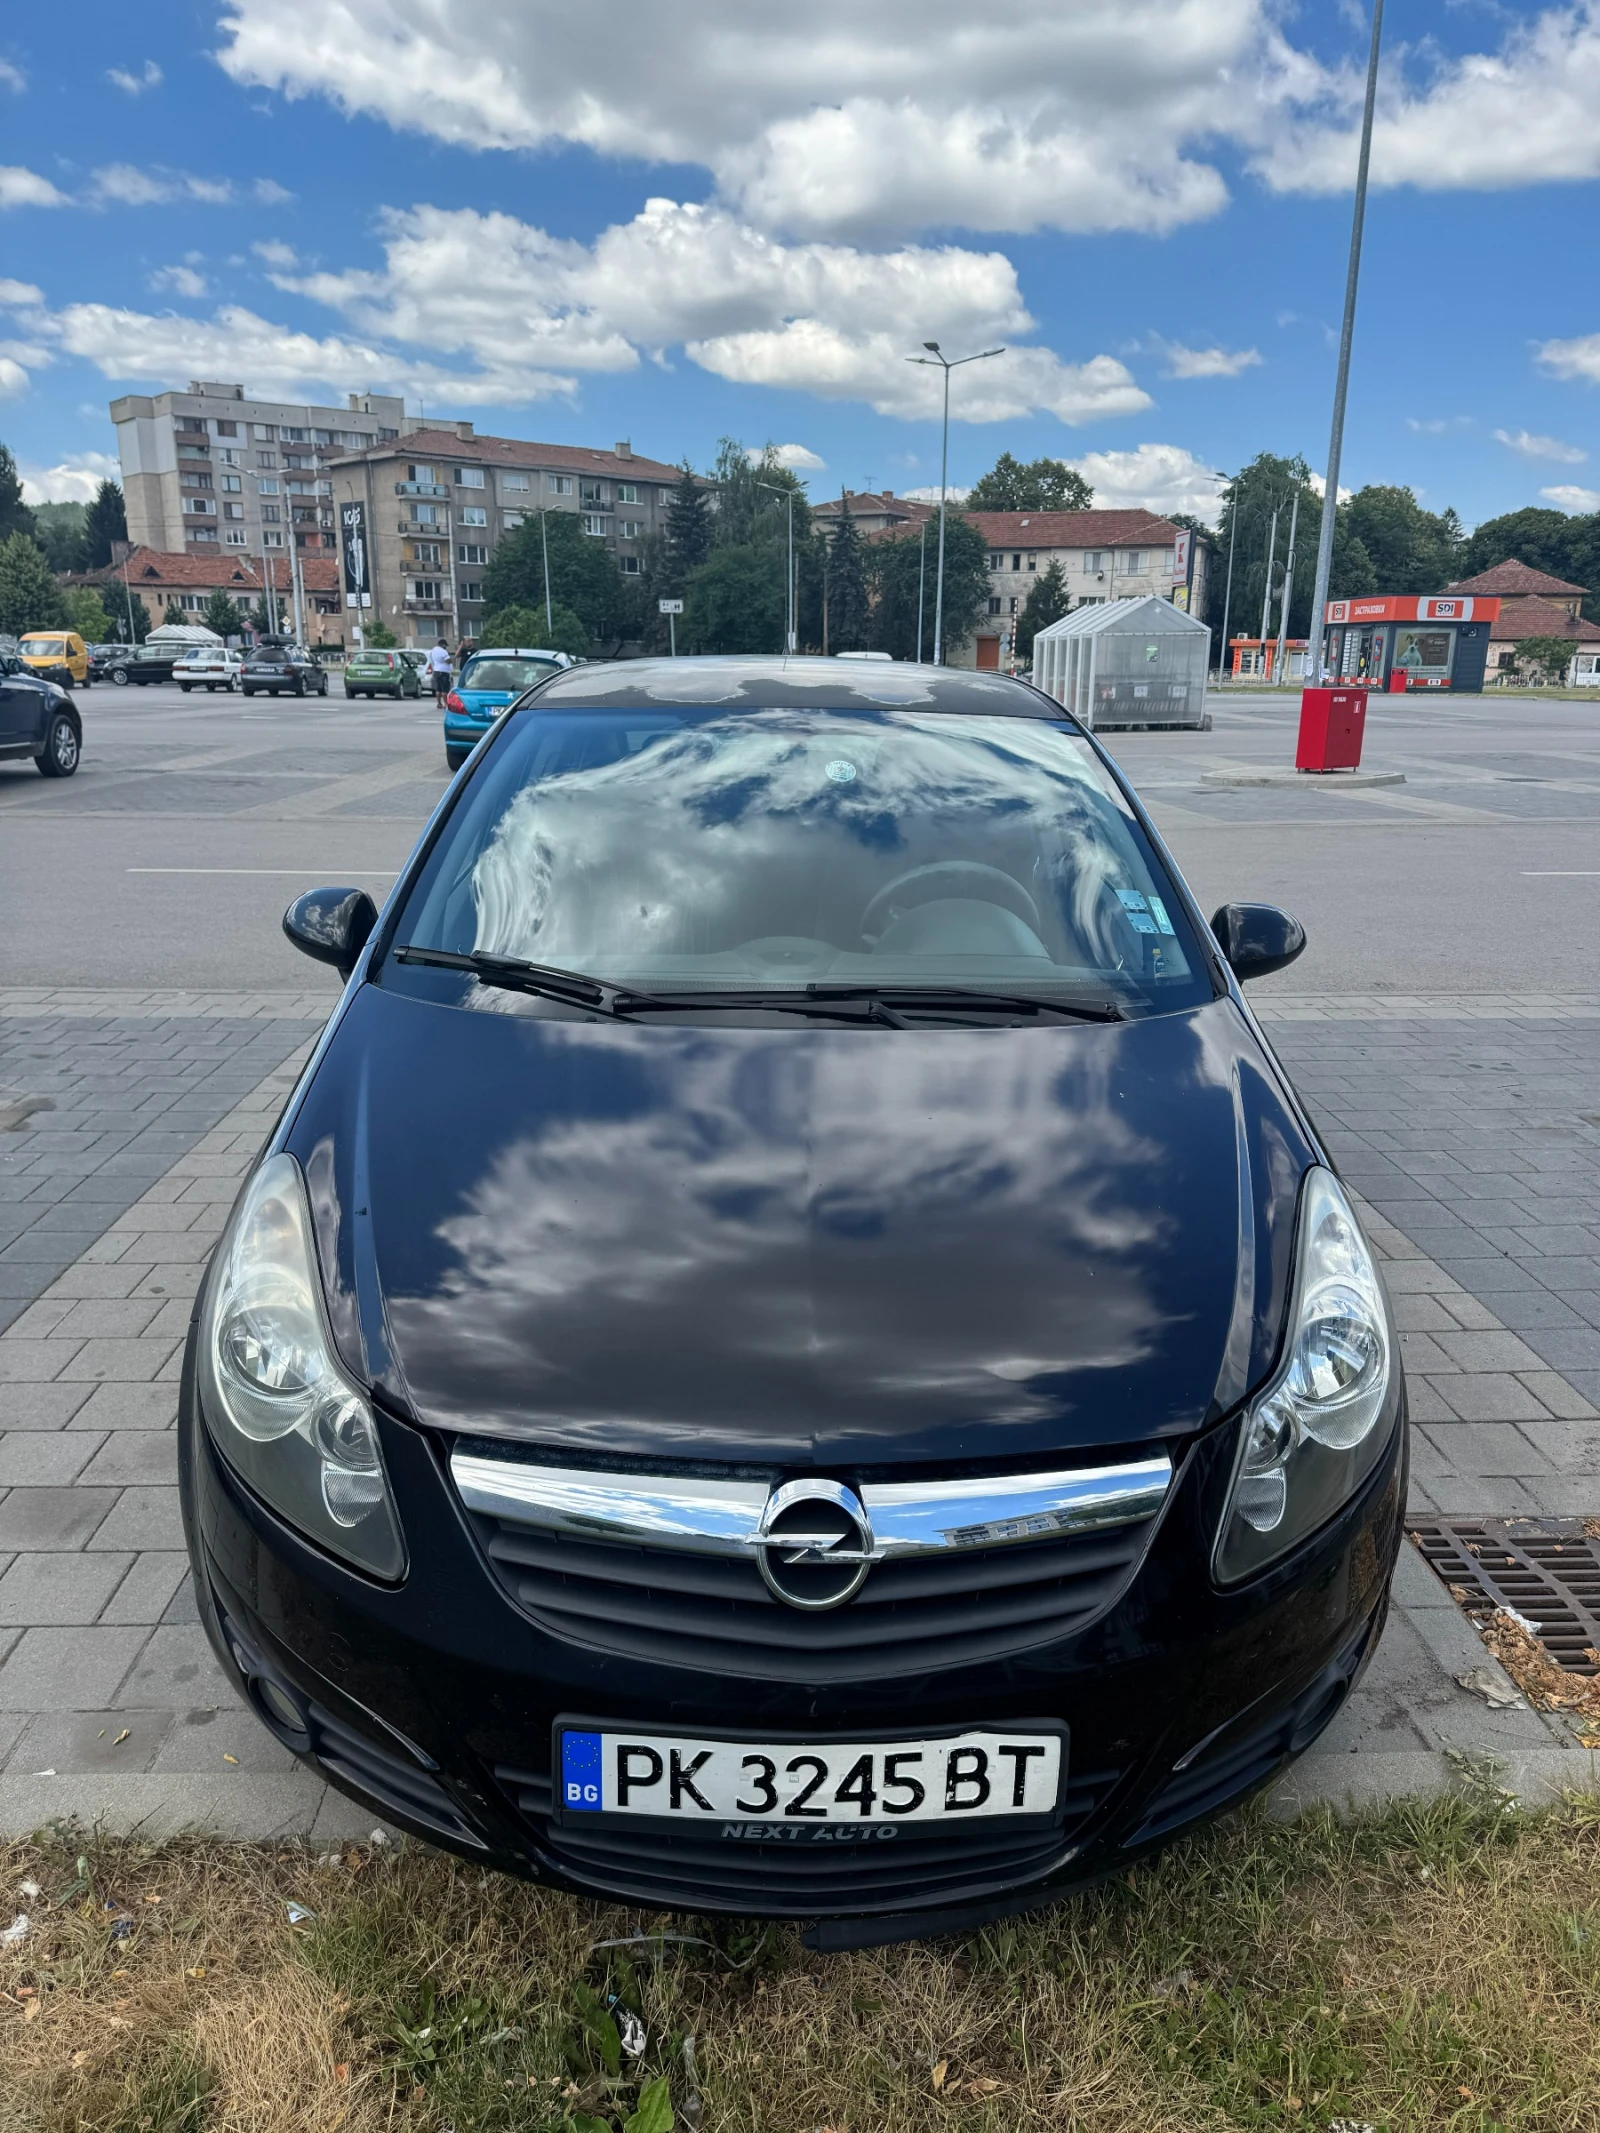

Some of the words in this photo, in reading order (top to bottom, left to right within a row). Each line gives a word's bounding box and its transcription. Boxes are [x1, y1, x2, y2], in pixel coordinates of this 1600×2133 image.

[1437, 603, 1454, 613] SDI
[616, 1743, 715, 1811] PK
[735, 1750, 926, 1816] 3245
[945, 1744, 1045, 1809] BT
[566, 1783, 598, 1802] BG
[720, 1822, 808, 1841] NEXT
[811, 1823, 899, 1841] AUTO
